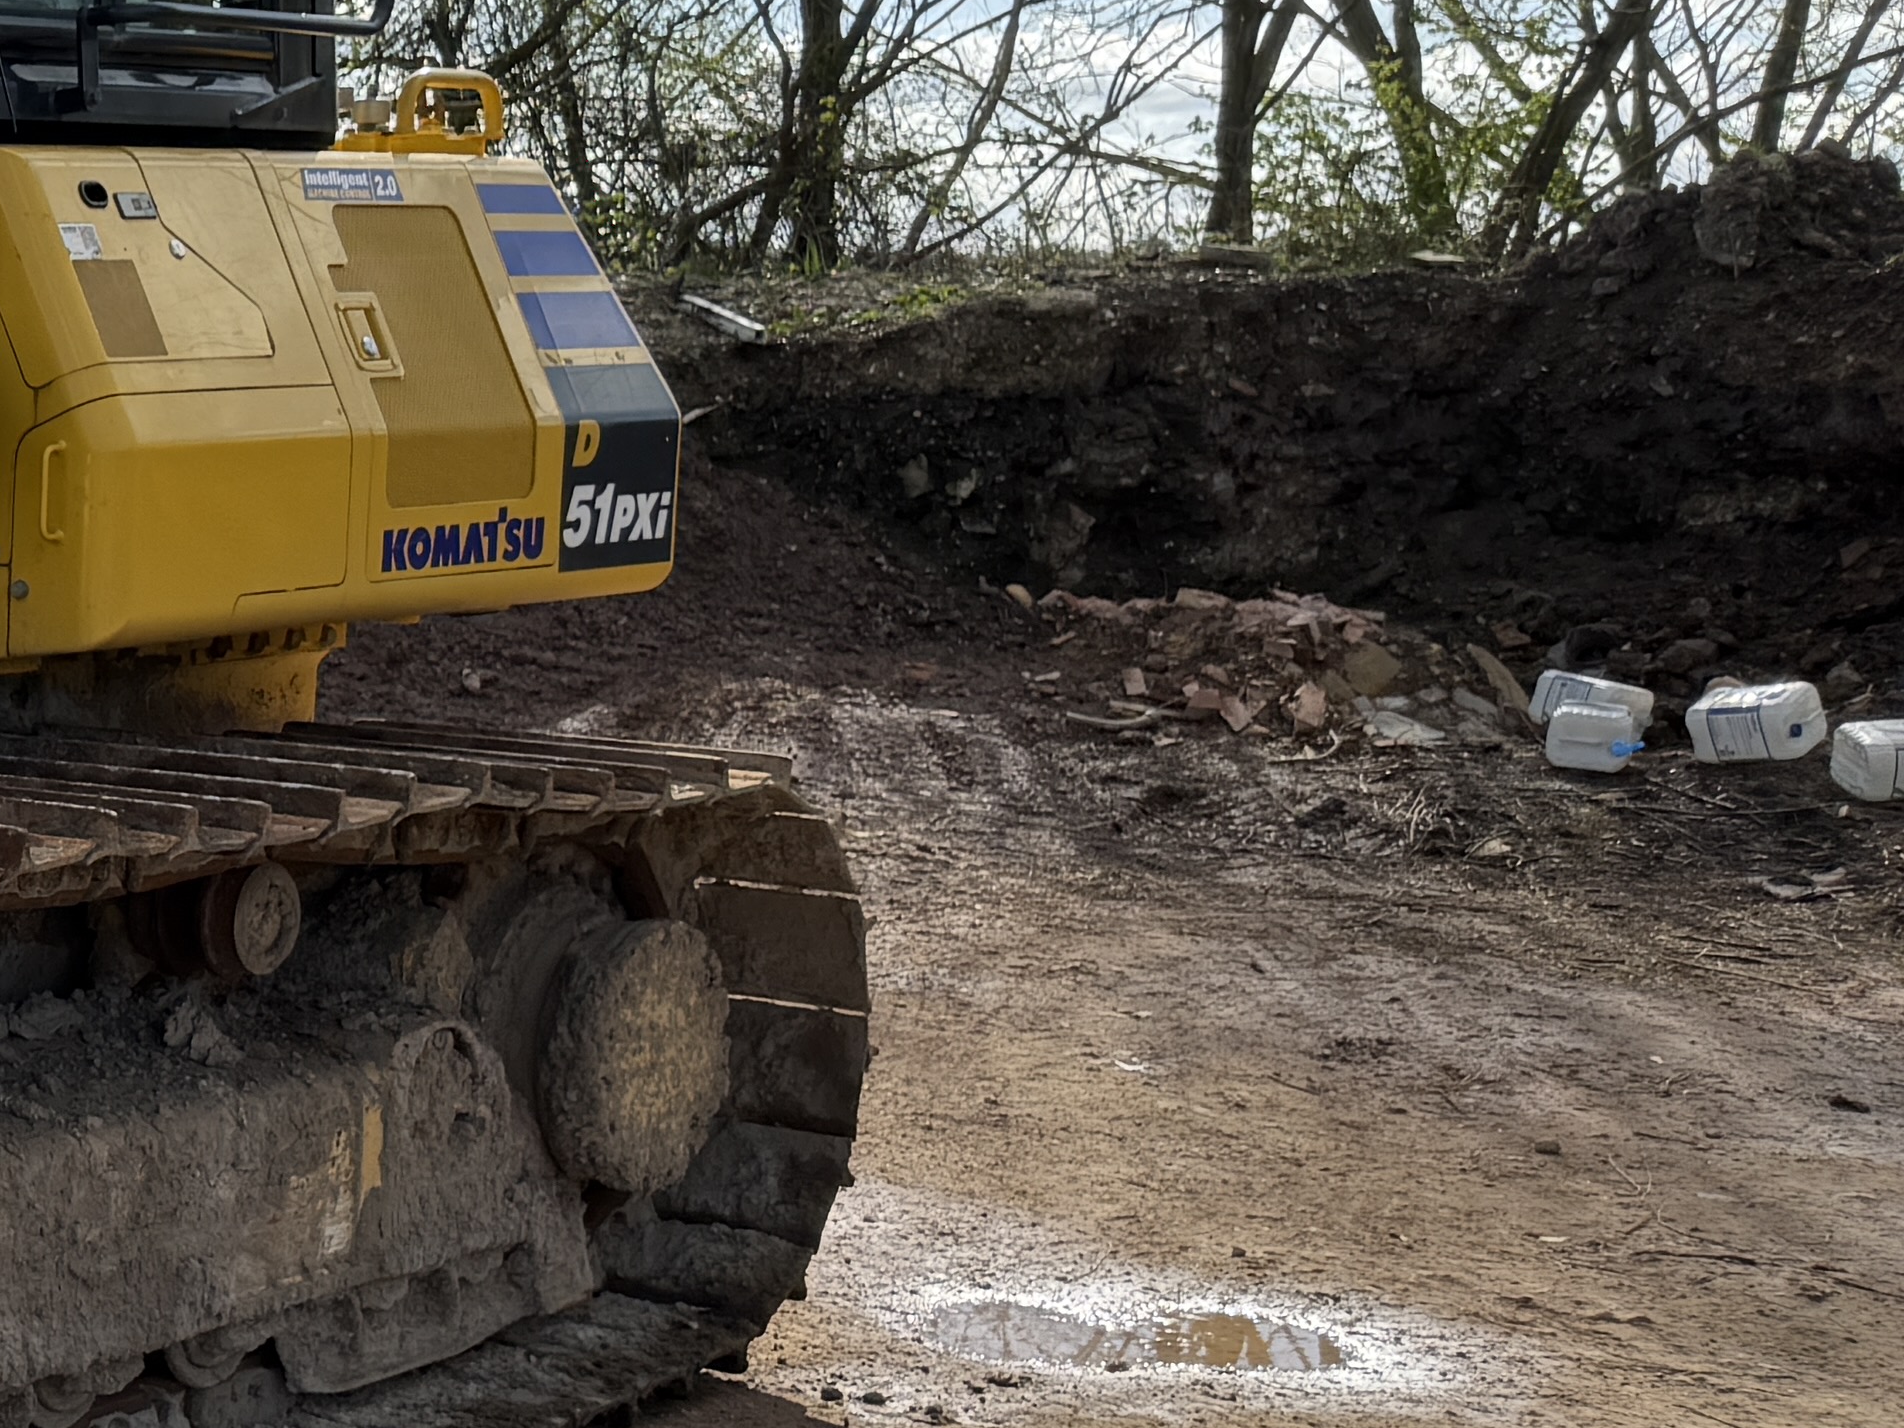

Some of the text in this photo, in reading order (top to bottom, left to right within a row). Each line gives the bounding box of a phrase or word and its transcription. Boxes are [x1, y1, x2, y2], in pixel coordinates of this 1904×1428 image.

[304, 170, 397, 196] Intelligent 2.0
[572, 419, 600, 467] D
[382, 507, 545, 573] KOMATSU
[563, 483, 671, 548] 51PXi
